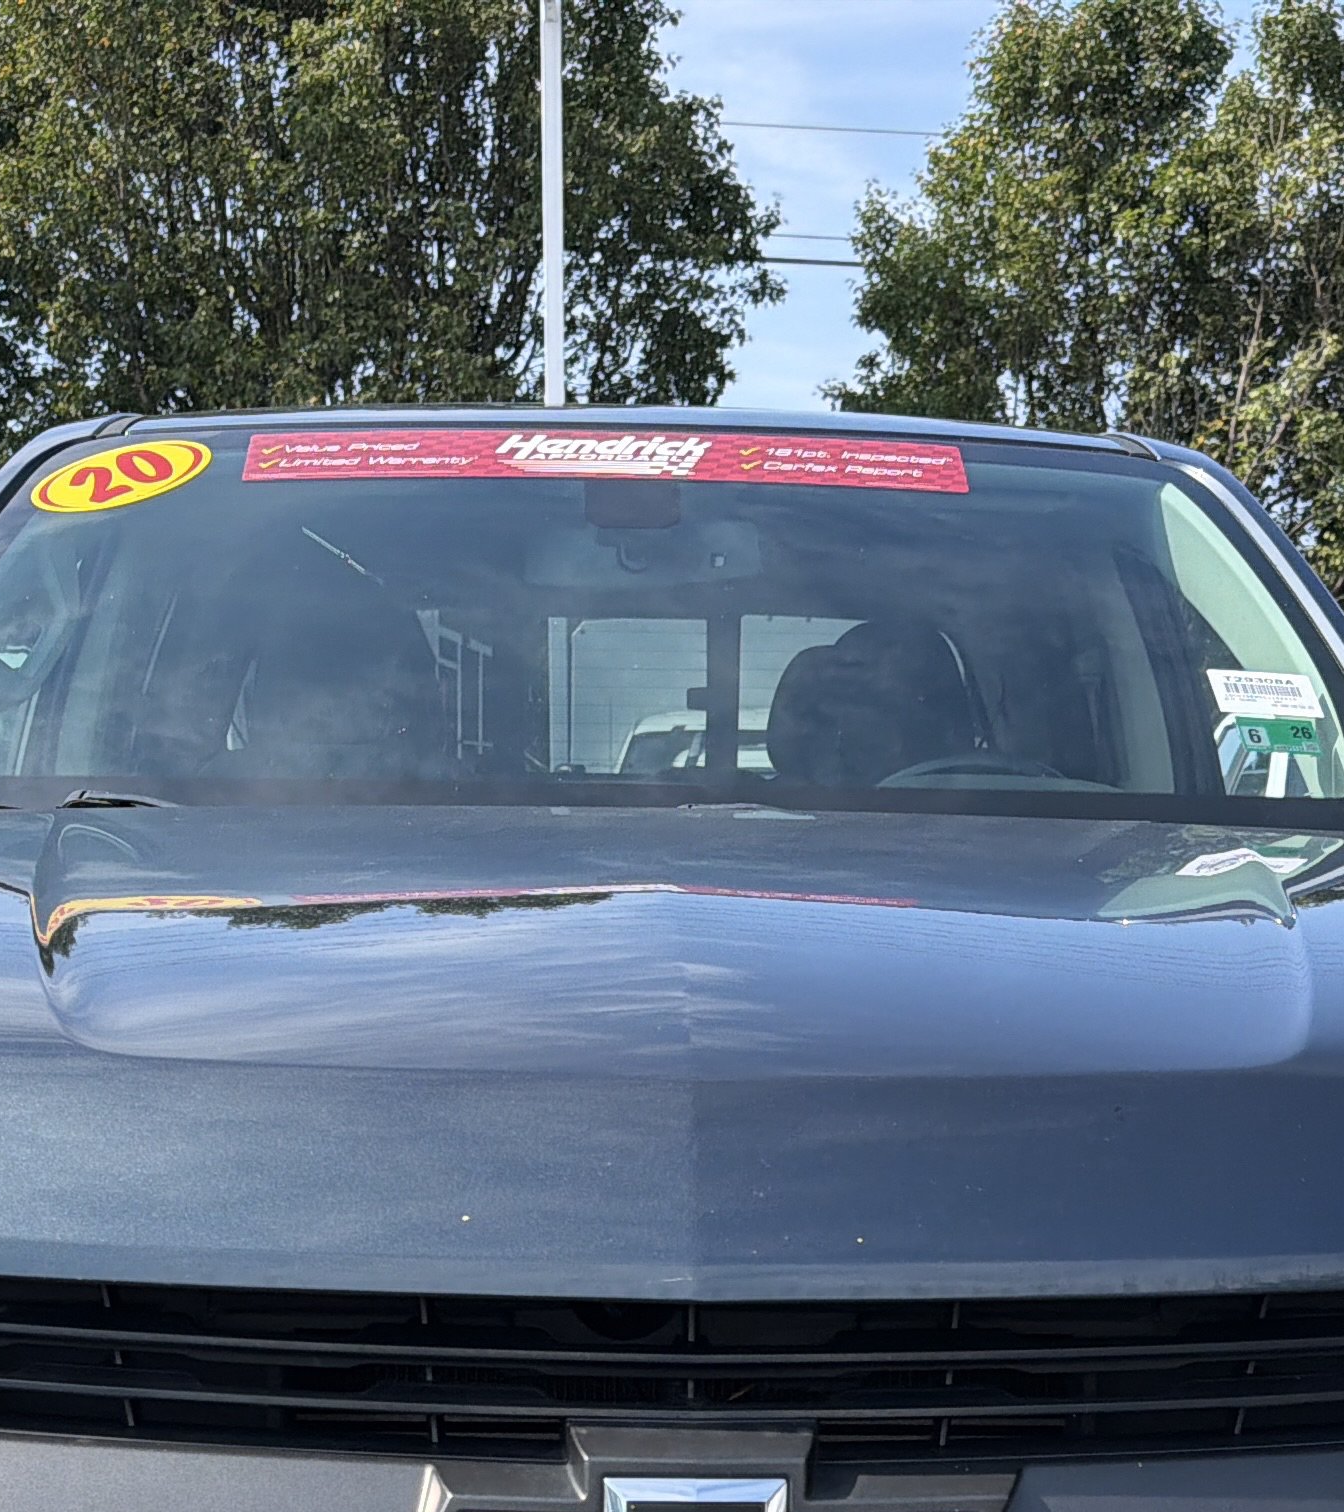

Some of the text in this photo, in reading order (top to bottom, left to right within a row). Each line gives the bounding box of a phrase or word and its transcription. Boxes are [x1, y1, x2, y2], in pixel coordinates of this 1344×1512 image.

[284, 441, 421, 454] Value Priced
[495, 434, 713, 460] Hendrick
[278, 456, 361, 468] Limited
[529, 453, 700, 463] AFFORDABLE
[69, 450, 174, 503] 20
[762, 461, 924, 478] Carfax Report
[1248, 728, 1262, 744] 6
[1290, 725, 1313, 740] 26
